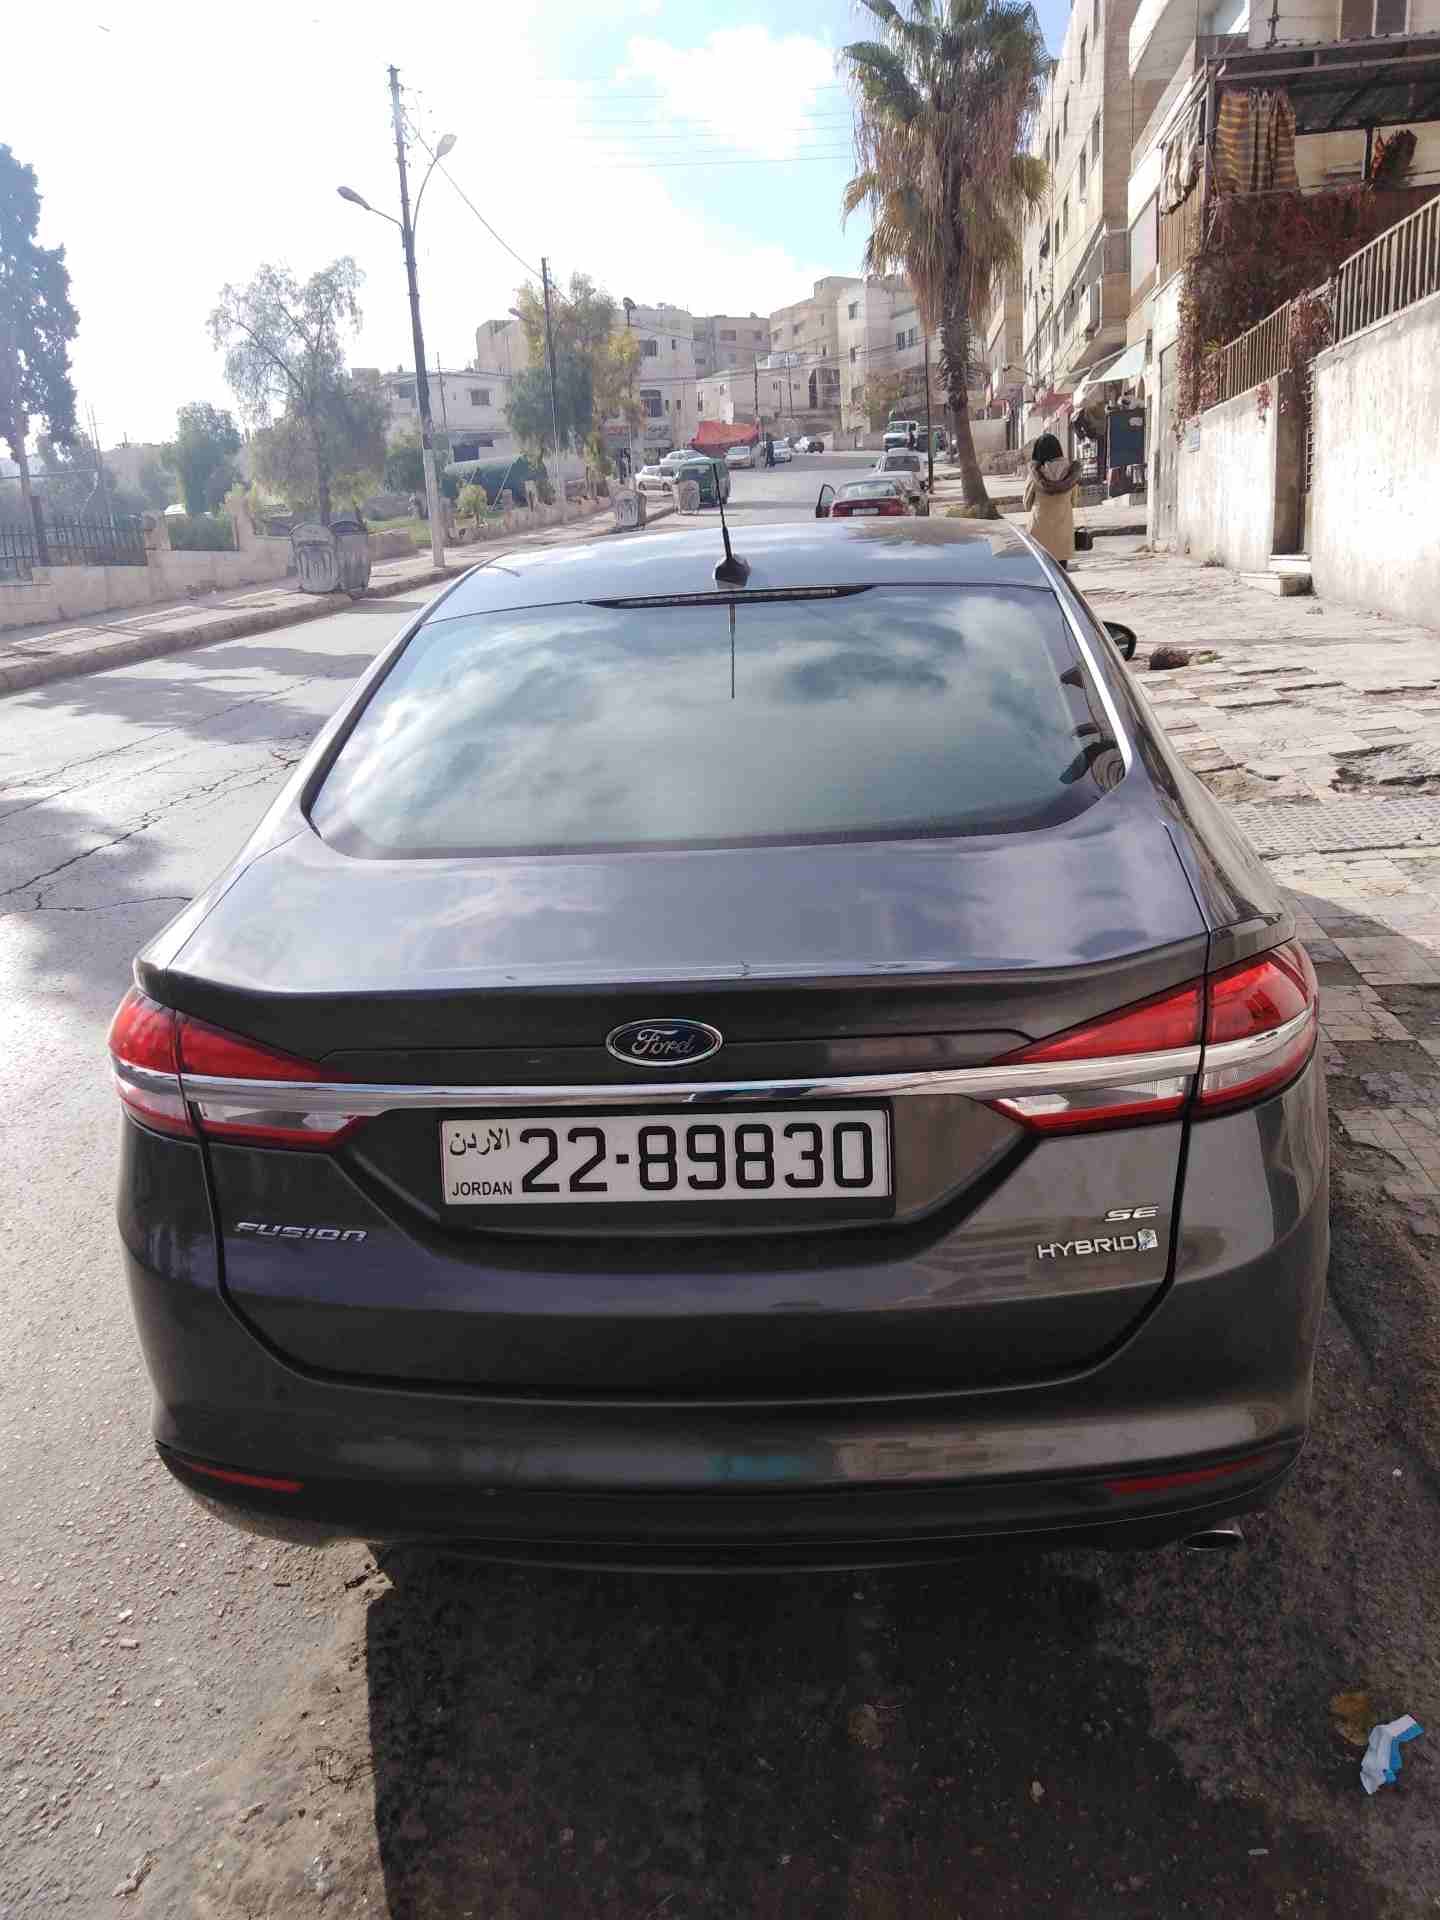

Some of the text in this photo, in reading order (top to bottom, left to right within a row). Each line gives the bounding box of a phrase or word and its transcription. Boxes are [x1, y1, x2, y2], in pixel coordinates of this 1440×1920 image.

[631, 1028, 696, 1055] Ford
[519, 1121, 874, 1193] 22-89830
[452, 1181, 513, 1197] JORDAN
[1104, 1205, 1160, 1222] SE
[234, 1221, 368, 1242] FUSION
[1037, 1235, 1138, 1259] HYBRID
